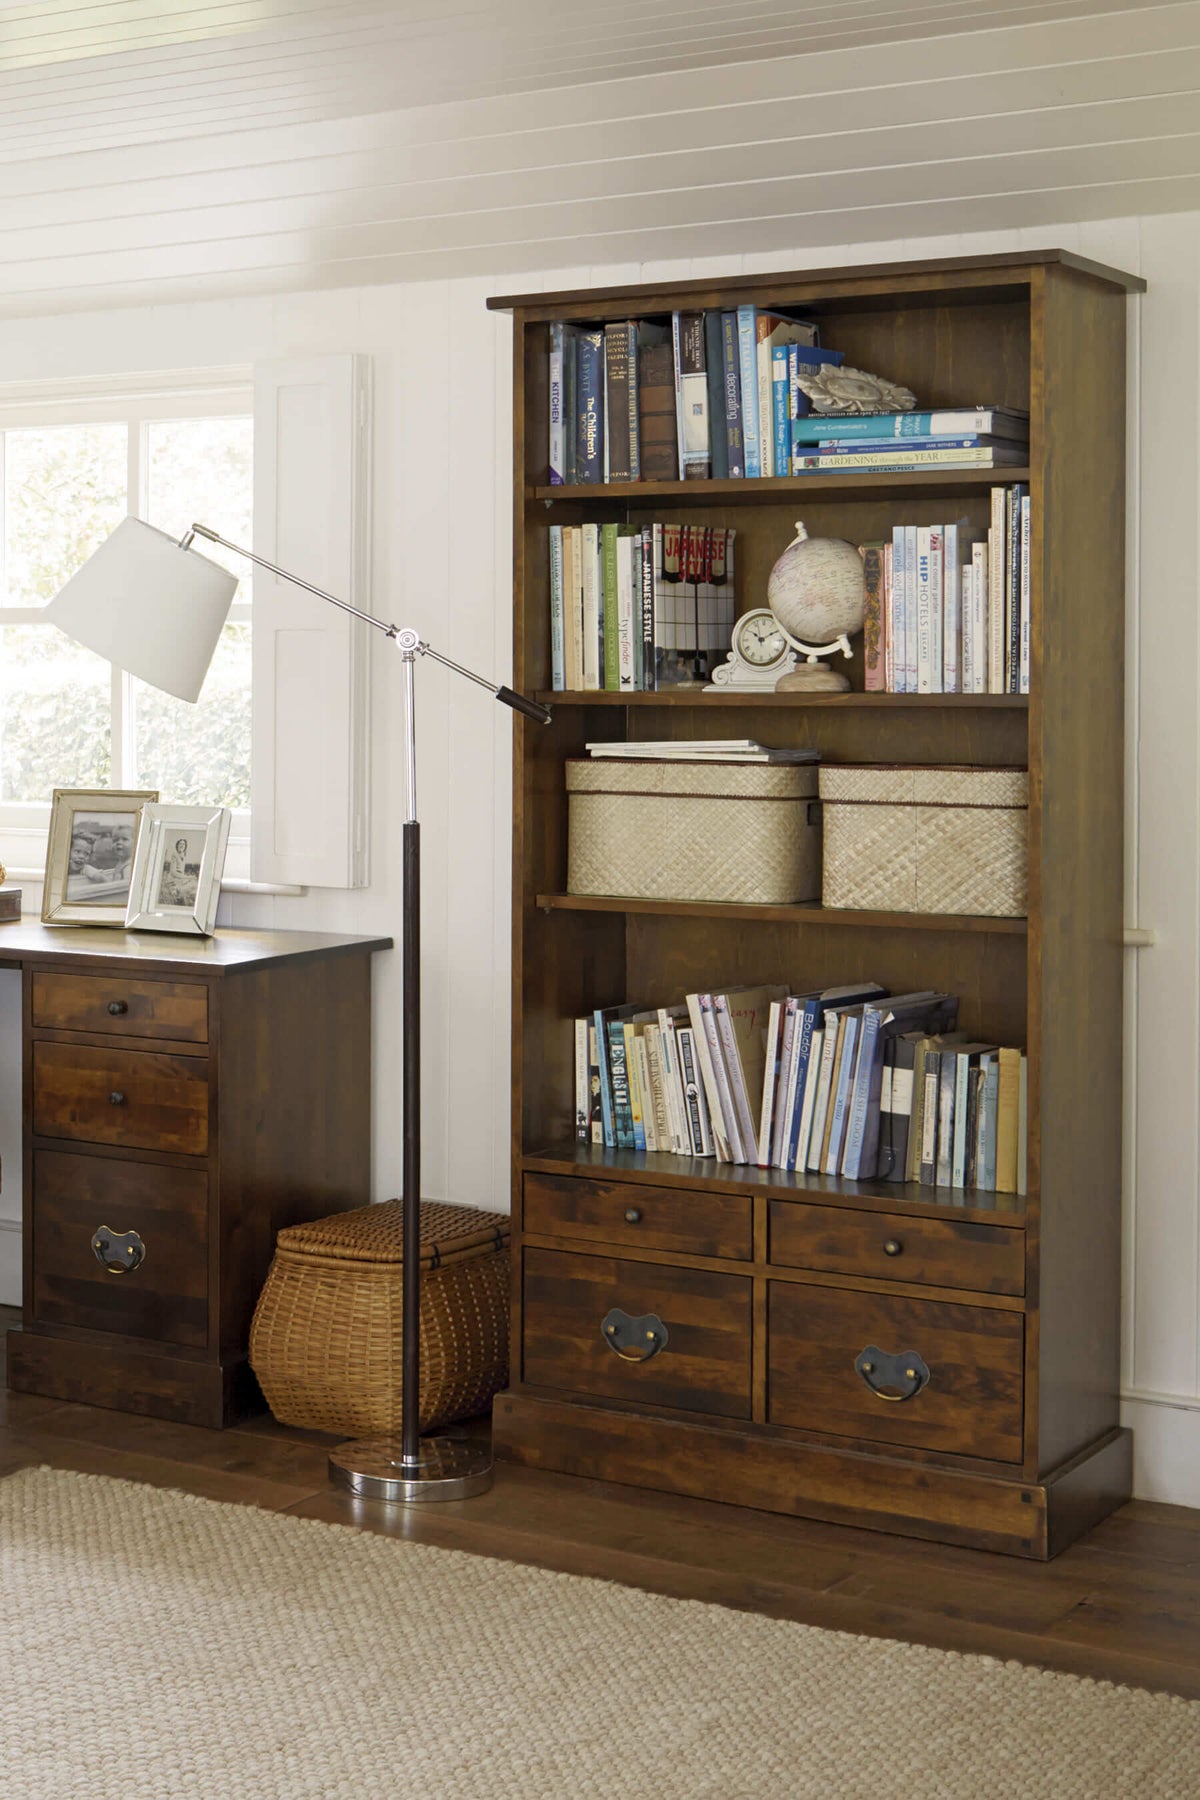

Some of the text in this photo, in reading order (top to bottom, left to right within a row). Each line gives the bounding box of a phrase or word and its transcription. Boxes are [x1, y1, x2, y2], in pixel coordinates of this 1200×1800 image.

[582, 363, 591, 393] BYATT
[628, 356, 636, 387] OTHER
[789, 352, 797, 420] WEIMARANERS
[552, 381, 560, 424] KITCHEN
[726, 373, 738, 420] decorating
[586, 396, 597, 460] The Children's
[629, 430, 638, 468] HOUSES
[820, 455, 878, 466] GARDENING
[914, 452, 939, 462] YEAR
[665, 536, 724, 561] JAPANESE
[678, 559, 712, 582] STYLE
[920, 555, 929, 582] HIP
[643, 560, 652, 643] JAPANESE STYLE
[920, 584, 929, 626] HOTELS
[621, 675, 631, 684] K
[731, 1010, 757, 1031] easy
[800, 1013, 815, 1061] Boudoir
[822, 1038, 833, 1061] junk
[611, 1044, 628, 1104] ENGLISH
[649, 1050, 665, 1108] THESAURUS
[850, 1115, 864, 1148] ROOM
